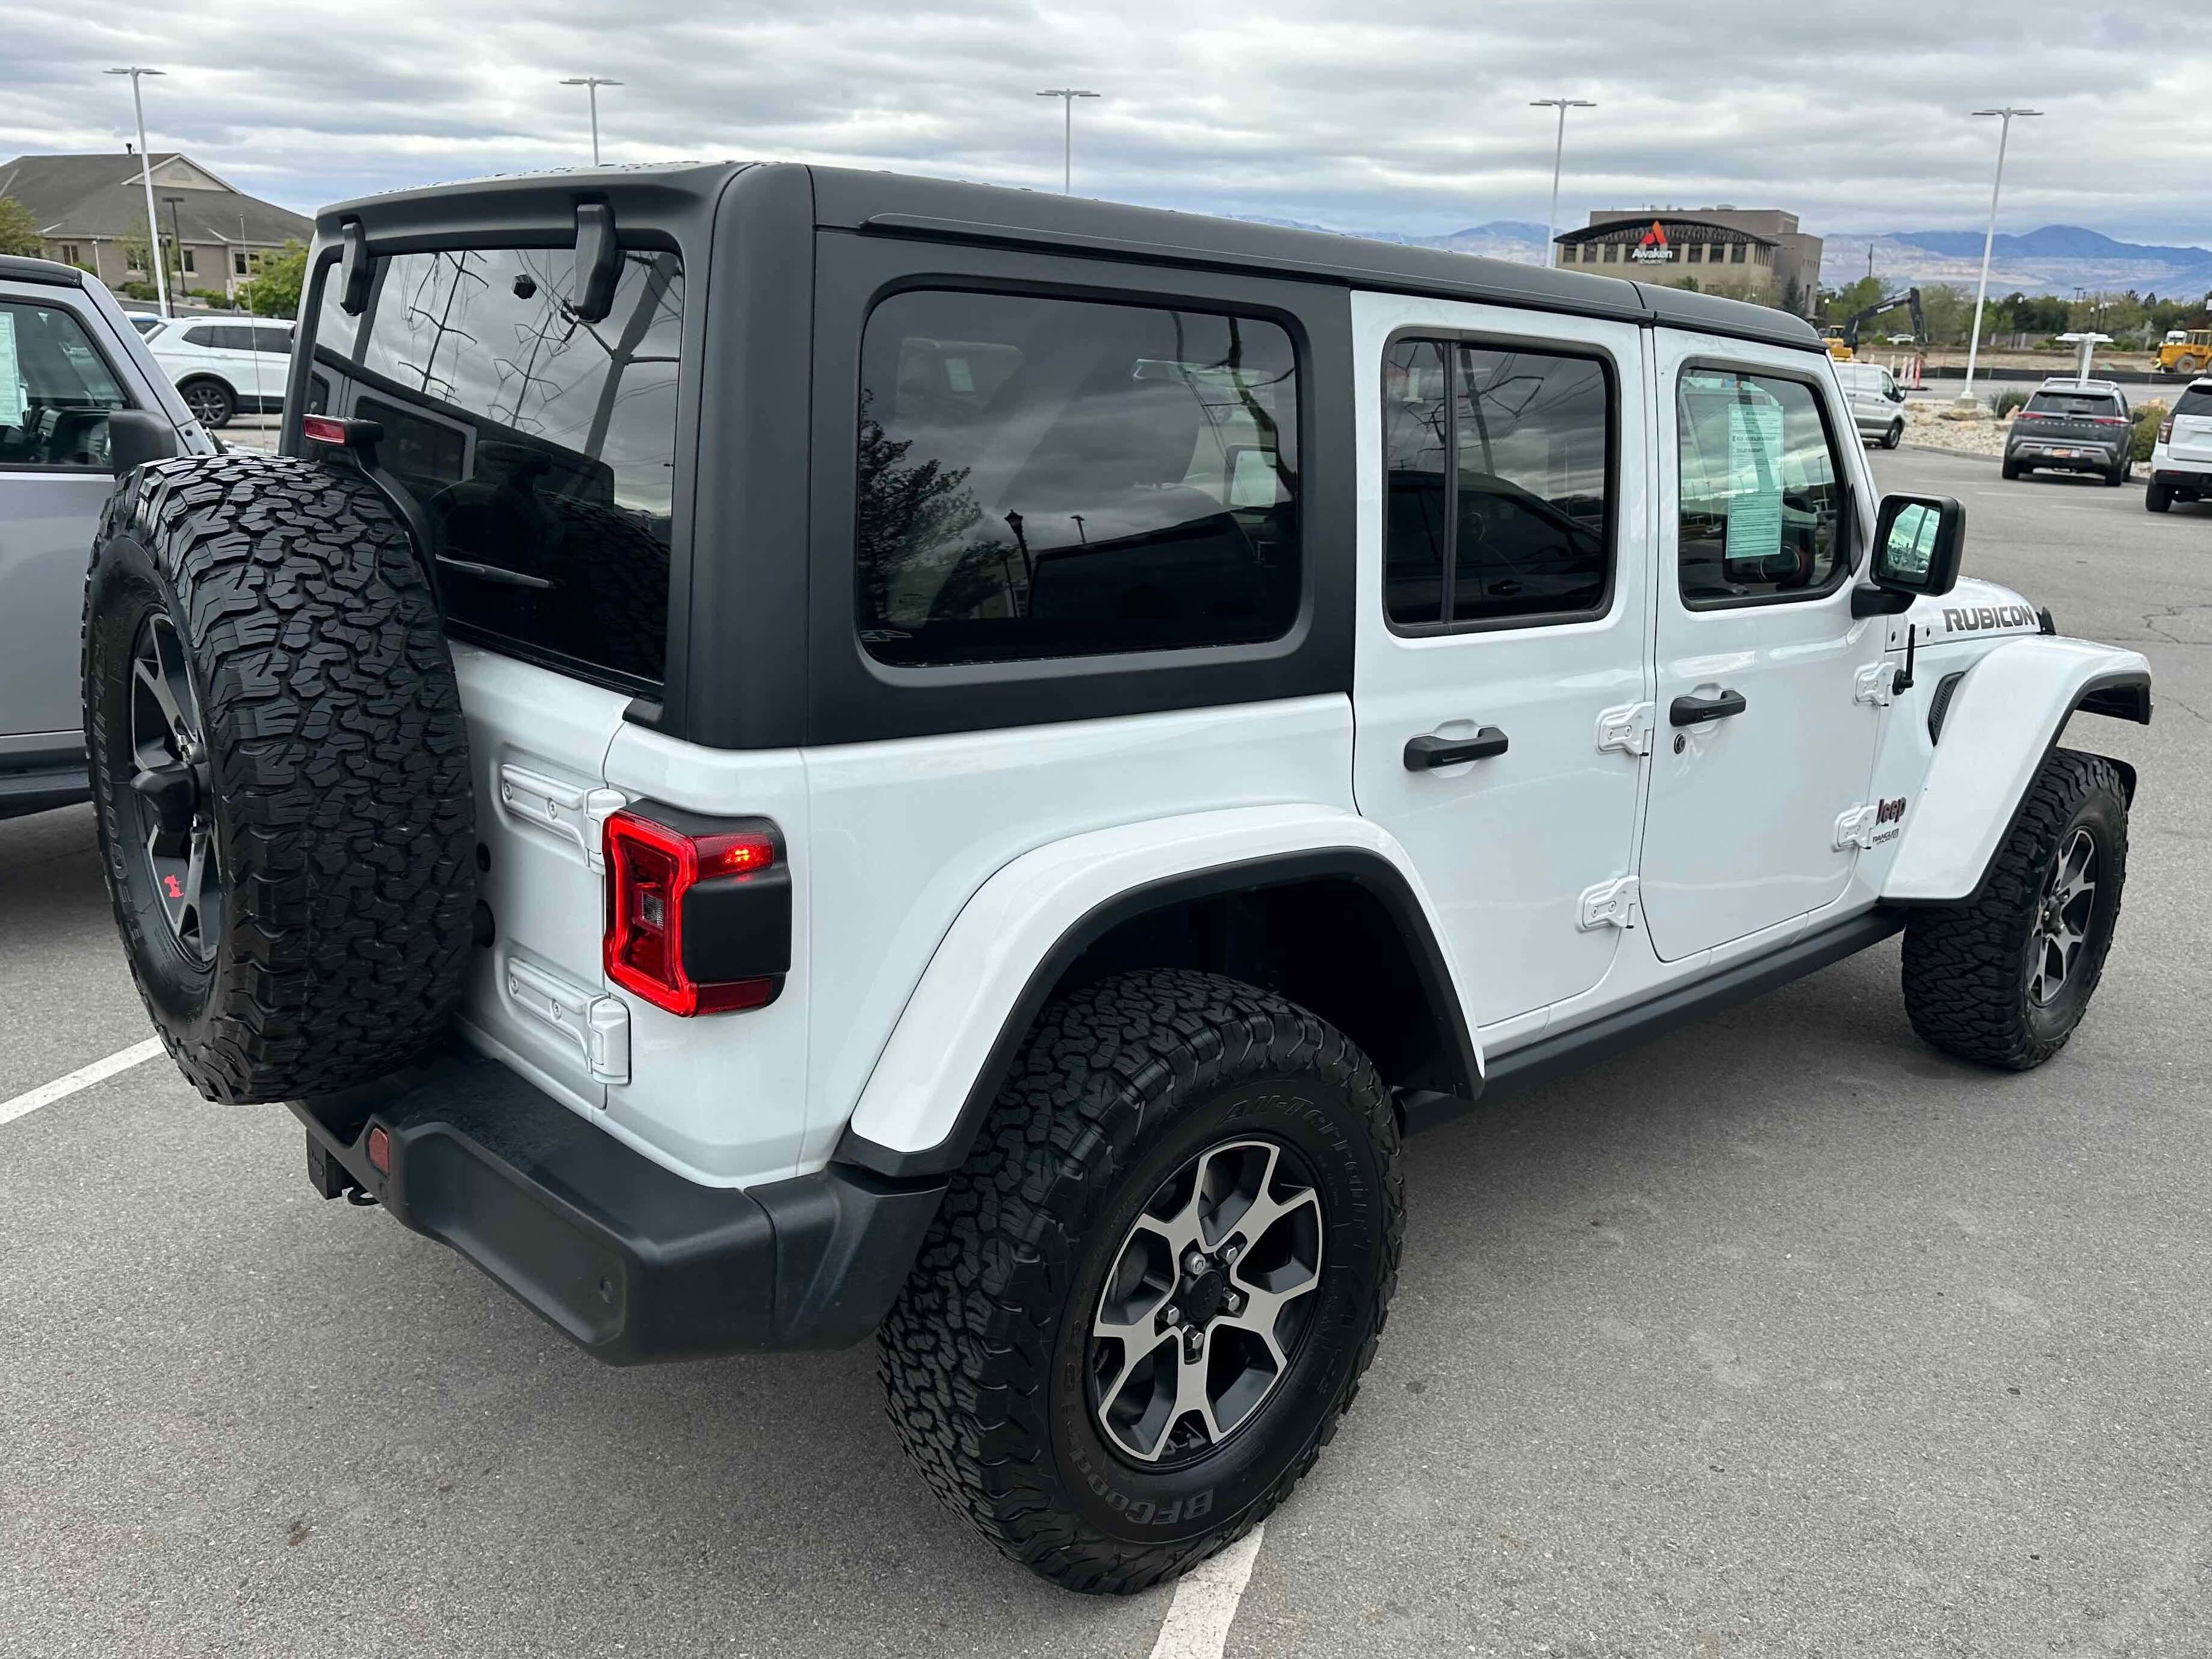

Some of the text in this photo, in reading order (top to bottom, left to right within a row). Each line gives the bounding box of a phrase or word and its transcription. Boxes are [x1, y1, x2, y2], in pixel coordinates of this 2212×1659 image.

[1632, 248, 1673, 259] Awaken
[1942, 605, 2036, 632] RUBICON
[1876, 797, 1906, 825] Jeep
